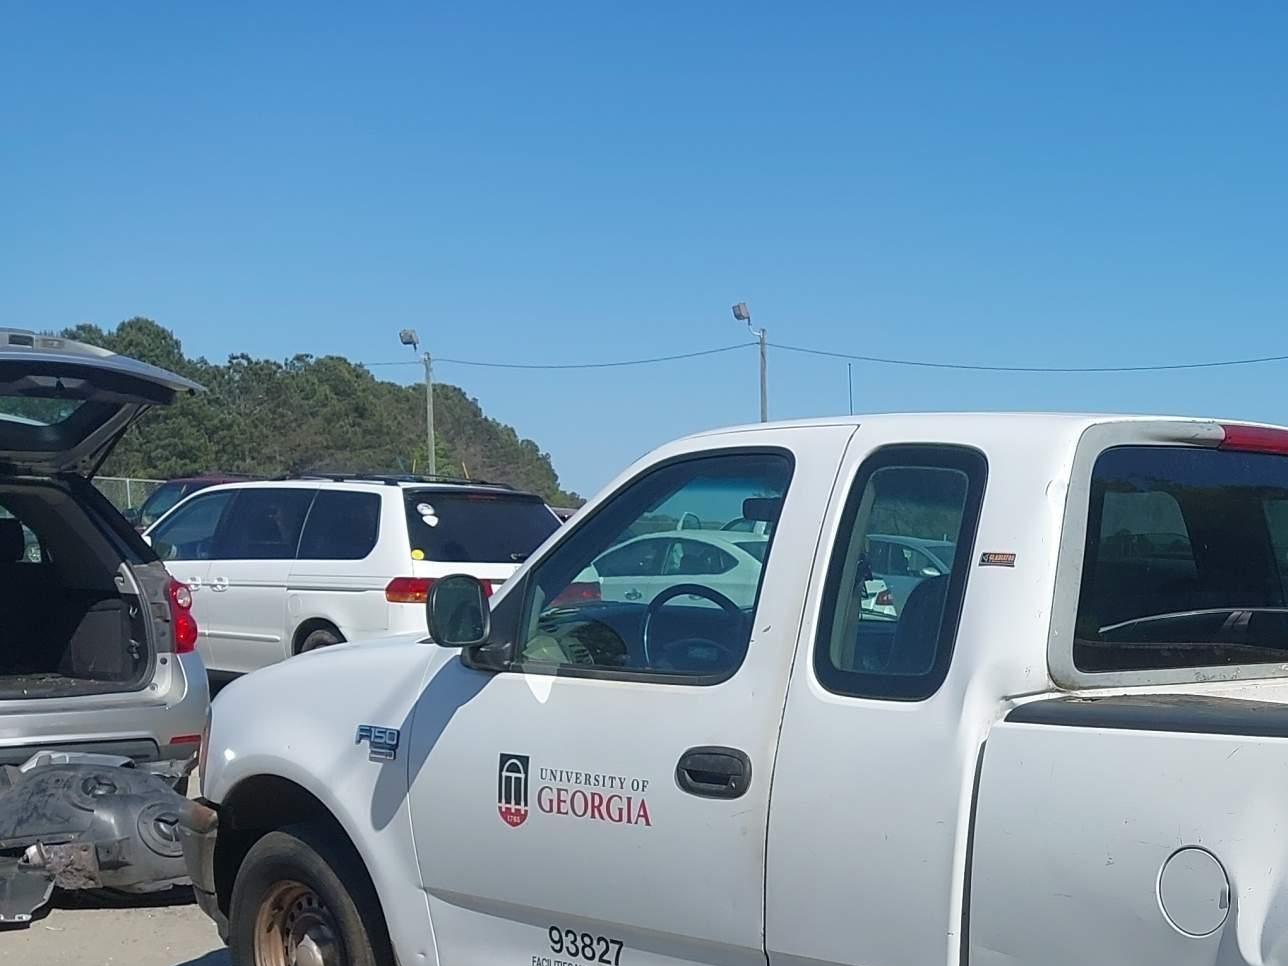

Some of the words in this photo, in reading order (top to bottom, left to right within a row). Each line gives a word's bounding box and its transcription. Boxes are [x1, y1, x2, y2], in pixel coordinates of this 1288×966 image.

[355, 725, 399, 745] F150
[540, 767, 626, 790] UNIVERSITY
[631, 778, 649, 792] OF
[537, 785, 652, 827] GEORGIA
[548, 925, 624, 966] 93827
